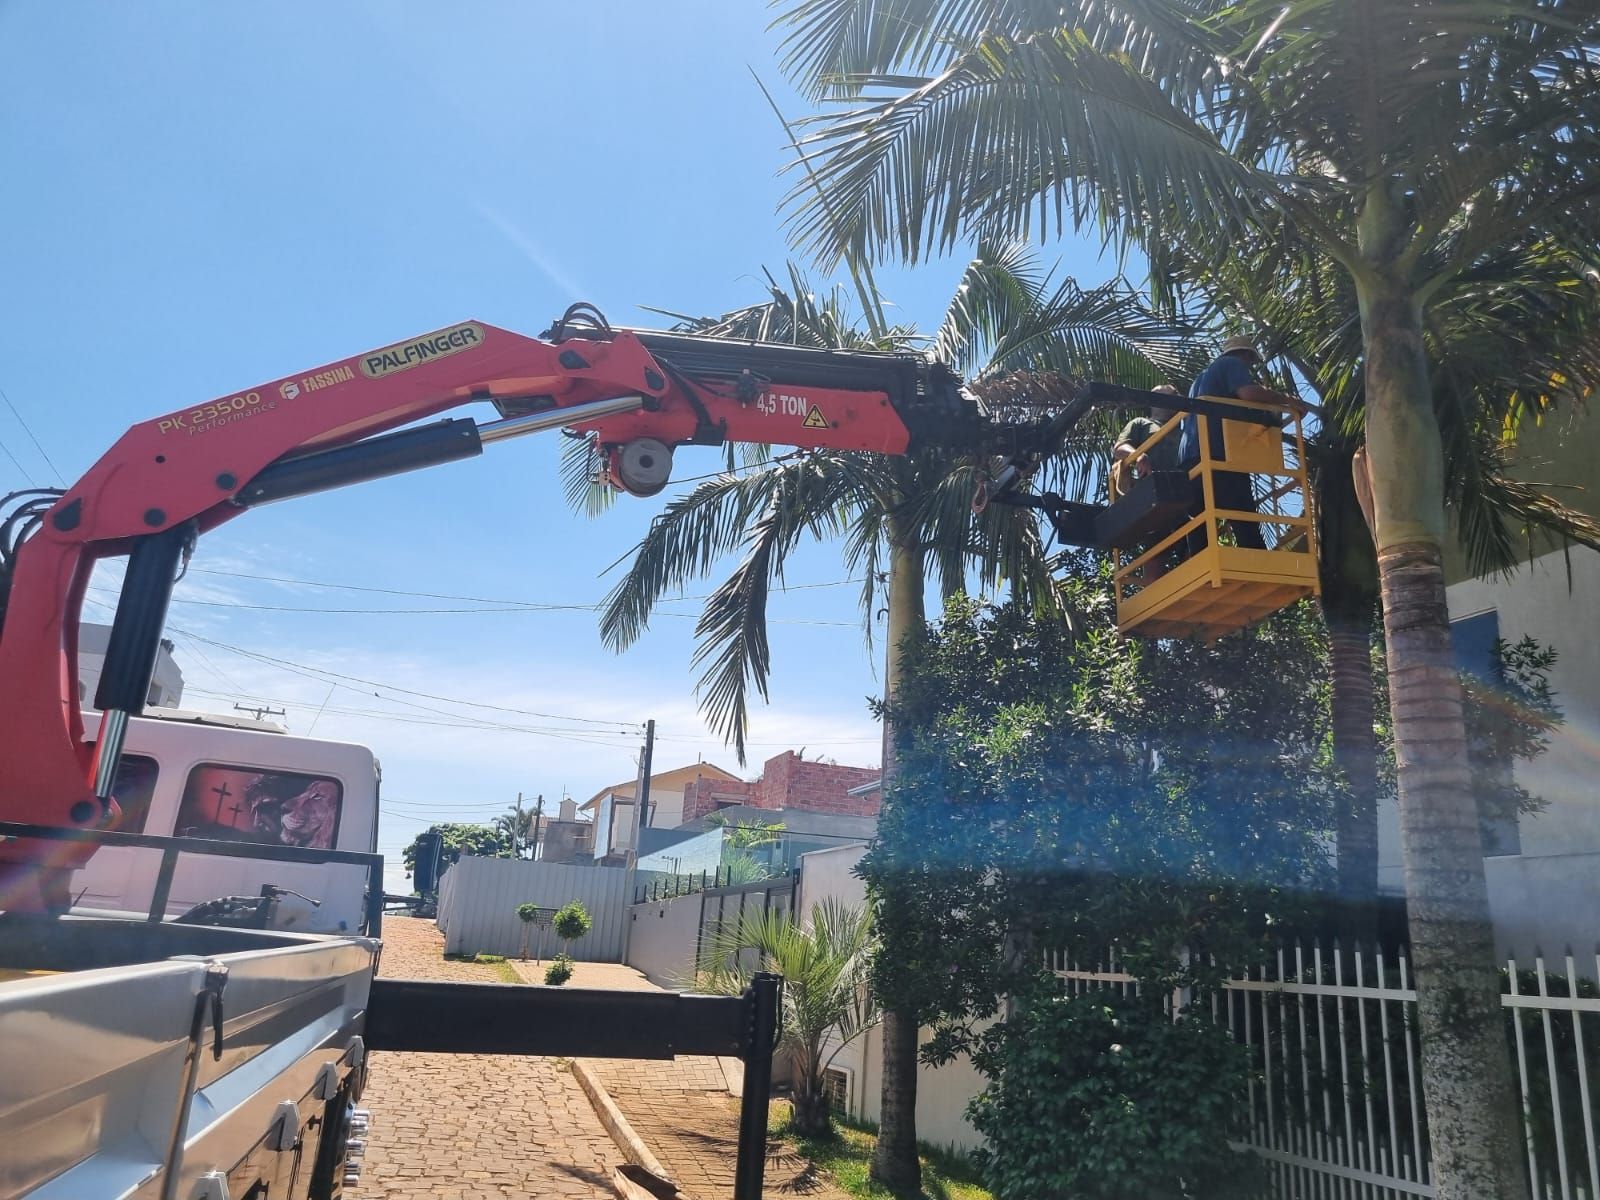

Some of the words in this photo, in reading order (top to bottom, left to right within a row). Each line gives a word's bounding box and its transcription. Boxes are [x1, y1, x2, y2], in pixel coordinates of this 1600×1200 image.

[366, 327, 478, 374] PALFINGER
[302, 366, 355, 393] FASSINA
[158, 415, 187, 434] PK
[190, 392, 261, 425] 23500
[189, 401, 276, 436] Performance
[757, 393, 776, 416] 4,5
[780, 395, 807, 416] TON
